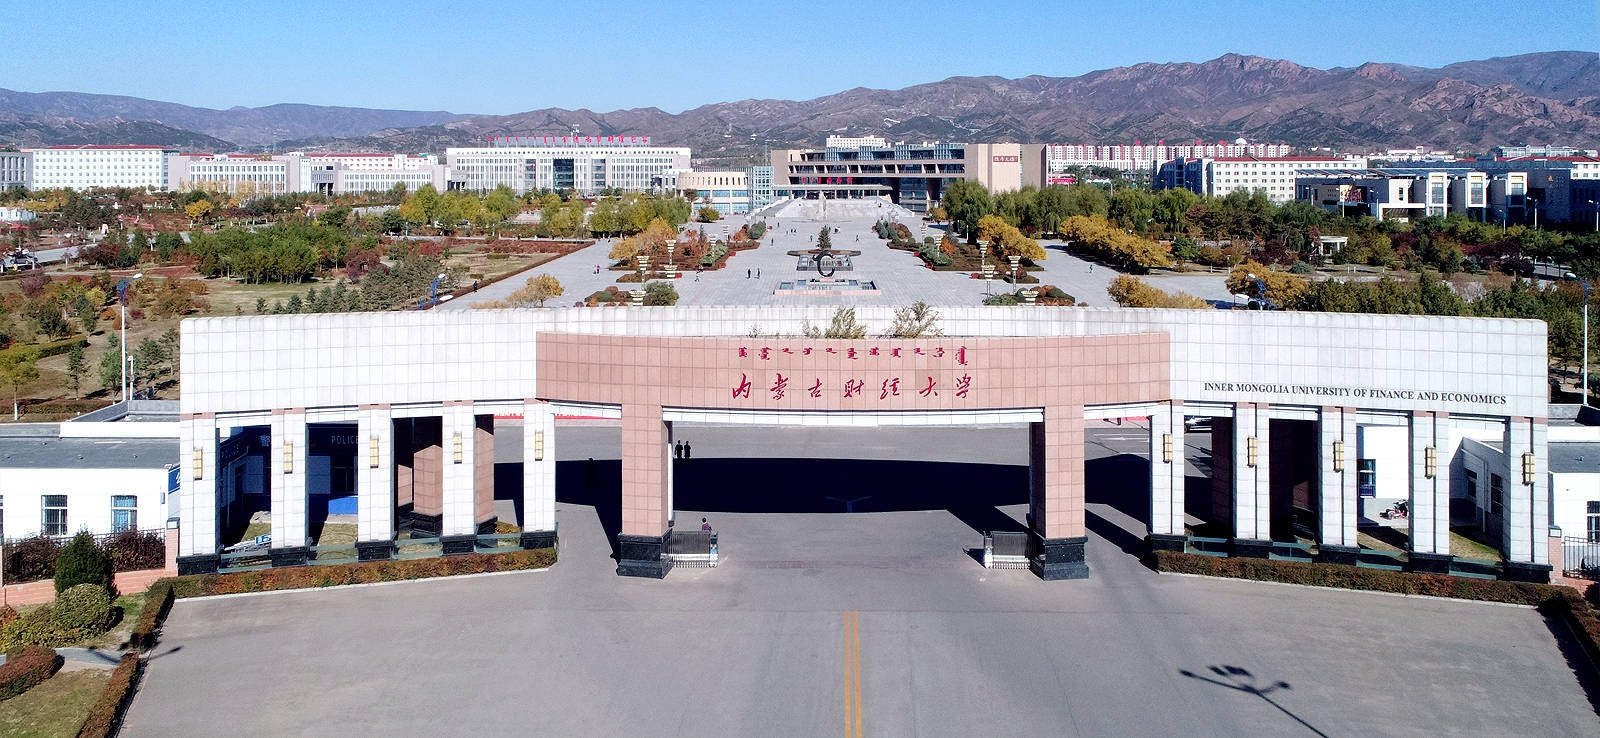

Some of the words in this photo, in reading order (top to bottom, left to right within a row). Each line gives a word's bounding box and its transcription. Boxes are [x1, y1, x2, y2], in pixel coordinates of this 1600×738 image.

[732, 373, 972, 401] 内蒙古财经大学
[1204, 382, 1234, 391] INNER
[1236, 383, 1290, 393] MONGOLIA
[1293, 386, 1350, 397] UNIVERSITY
[1353, 388, 1368, 397] OF
[1370, 389, 1414, 400] FINANCE
[1417, 391, 1439, 401] AND
[1441, 393, 1507, 405] ECONOMICS
